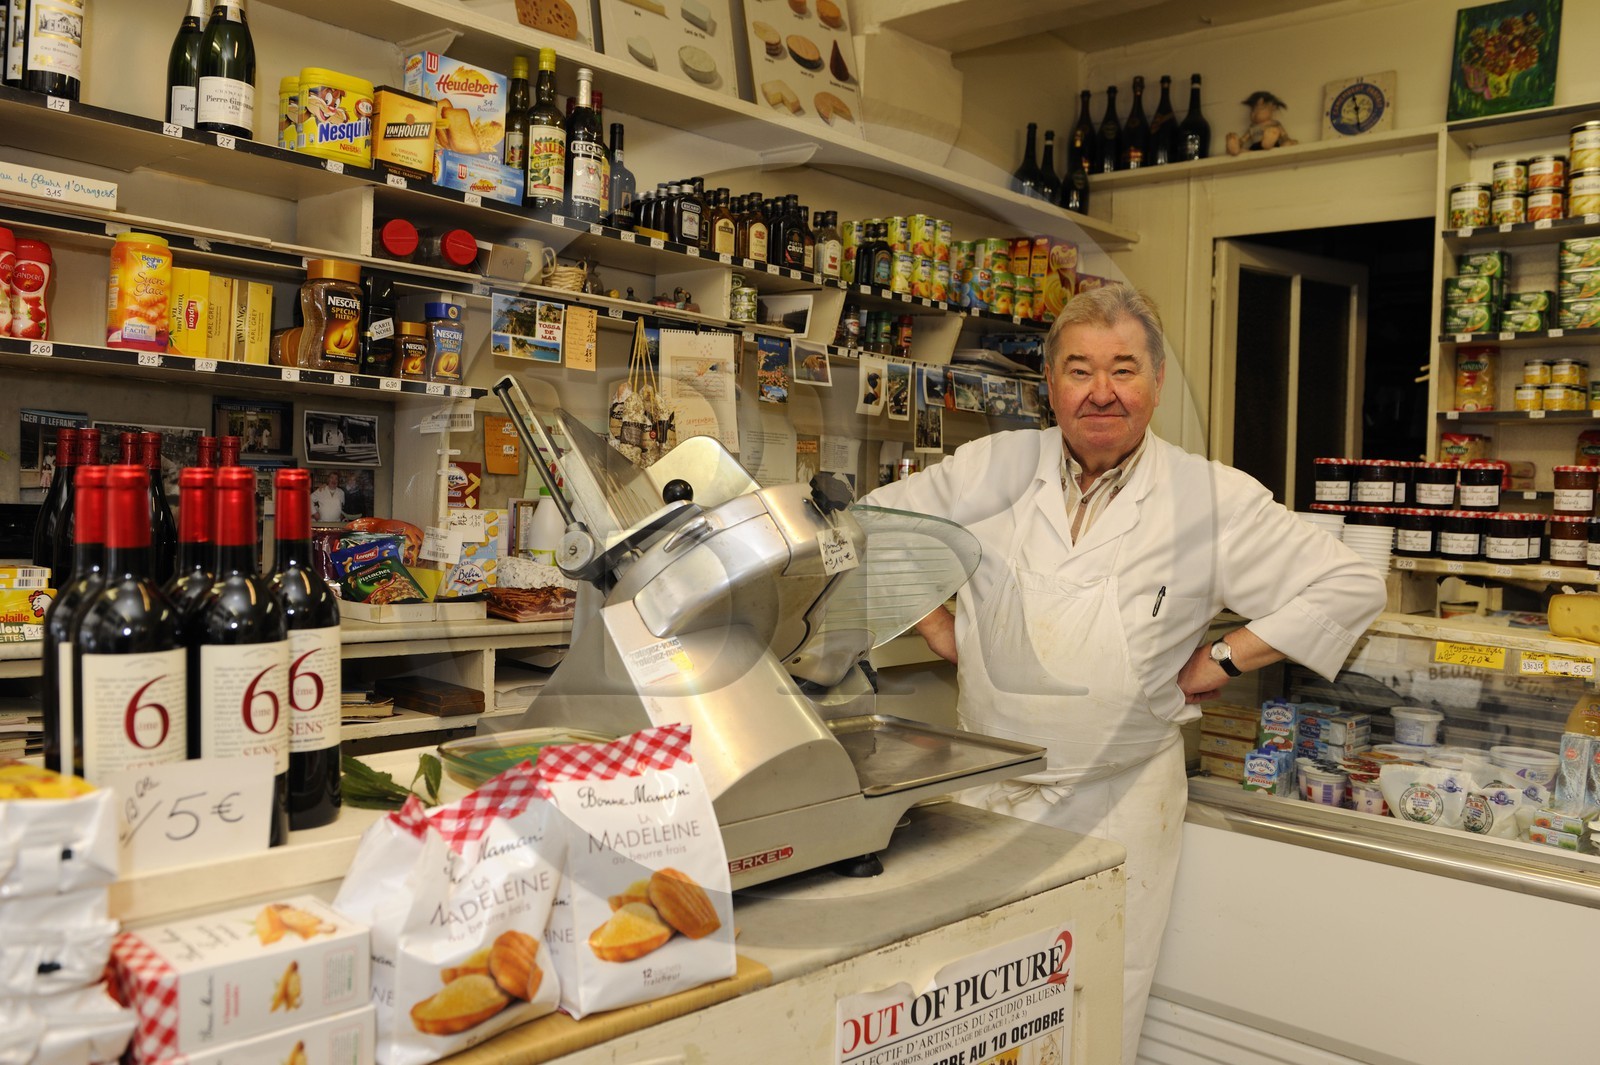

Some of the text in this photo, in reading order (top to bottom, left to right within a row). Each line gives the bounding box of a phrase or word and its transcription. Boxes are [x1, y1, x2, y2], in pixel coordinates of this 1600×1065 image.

[427, 54, 438, 72] LU
[435, 74, 498, 95] Heudebert
[50, 101, 65, 110] 17
[206, 95, 228, 103] Pierre
[482, 99, 493, 107] 34
[180, 104, 195, 112] Pier
[318, 119, 371, 143] Nesquik
[386, 123, 430, 137] VAN HOUTEN
[219, 138, 231, 147] 27
[141, 255, 163, 264] Beghin
[146, 261, 158, 270] Say
[134, 271, 165, 286] Sucre
[136, 284, 165, 297] Glace
[188, 301, 196, 328] Lipton
[237, 304, 249, 345] TWININGS
[539, 323, 561, 331] TOSSA
[32, 344, 51, 356] 2,60
[140, 354, 156, 365] 2,95
[49, 417, 77, 429] LEFRANC
[458, 568, 481, 581] Belin
[0, 613, 29, 623] olaille
[1460, 654, 1483, 665] 2,70
[1574, 664, 1592, 675] 5,65
[288, 648, 324, 711] 6
[242, 664, 280, 735] 6
[124, 674, 170, 750] 6
[577, 784, 690, 808] Bonne Maman
[165, 792, 207, 841] 5
[211, 792, 244, 823] €
[588, 820, 702, 854] MADELEINE
[730, 850, 790, 873] ERKEL
[643, 969, 653, 979] 12
[842, 1001, 904, 1054] OUT
[910, 986, 949, 1027] OF
[954, 945, 1064, 1013] PICTURE
[906, 1023, 969, 1056] D'ARTISTES
[971, 1016, 985, 1031] DU
[988, 1000, 1023, 1027] STUDIO
[1026, 983, 1067, 1007] BLUESKY
[970, 1043, 987, 1063] AU
[992, 1036, 1006, 1052] 10
[1011, 1007, 1065, 1044] OCTOBRE
